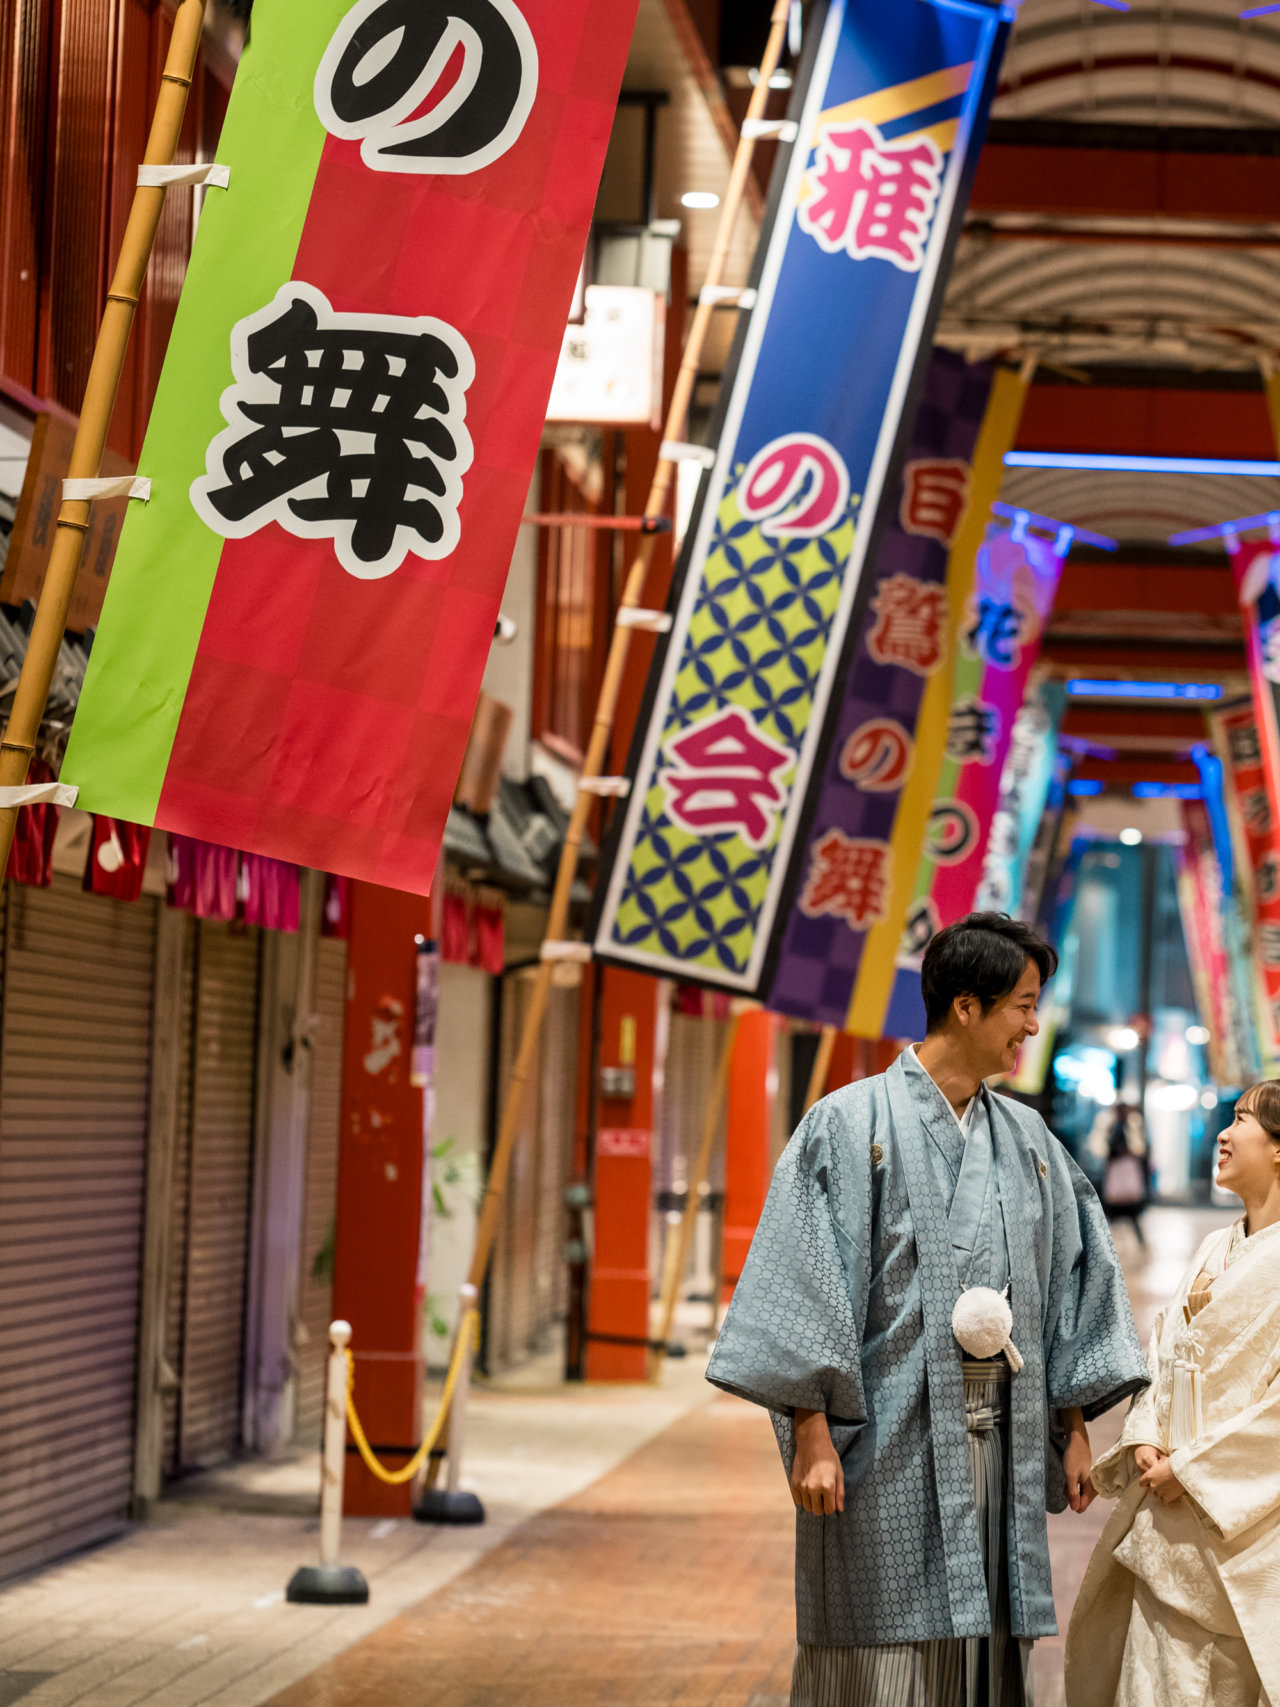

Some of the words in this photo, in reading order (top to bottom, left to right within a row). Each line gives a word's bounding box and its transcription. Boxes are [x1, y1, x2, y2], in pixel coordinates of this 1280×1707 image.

[197, 0, 532, 572] の舞
[661, 122, 940, 847] 雅の会
